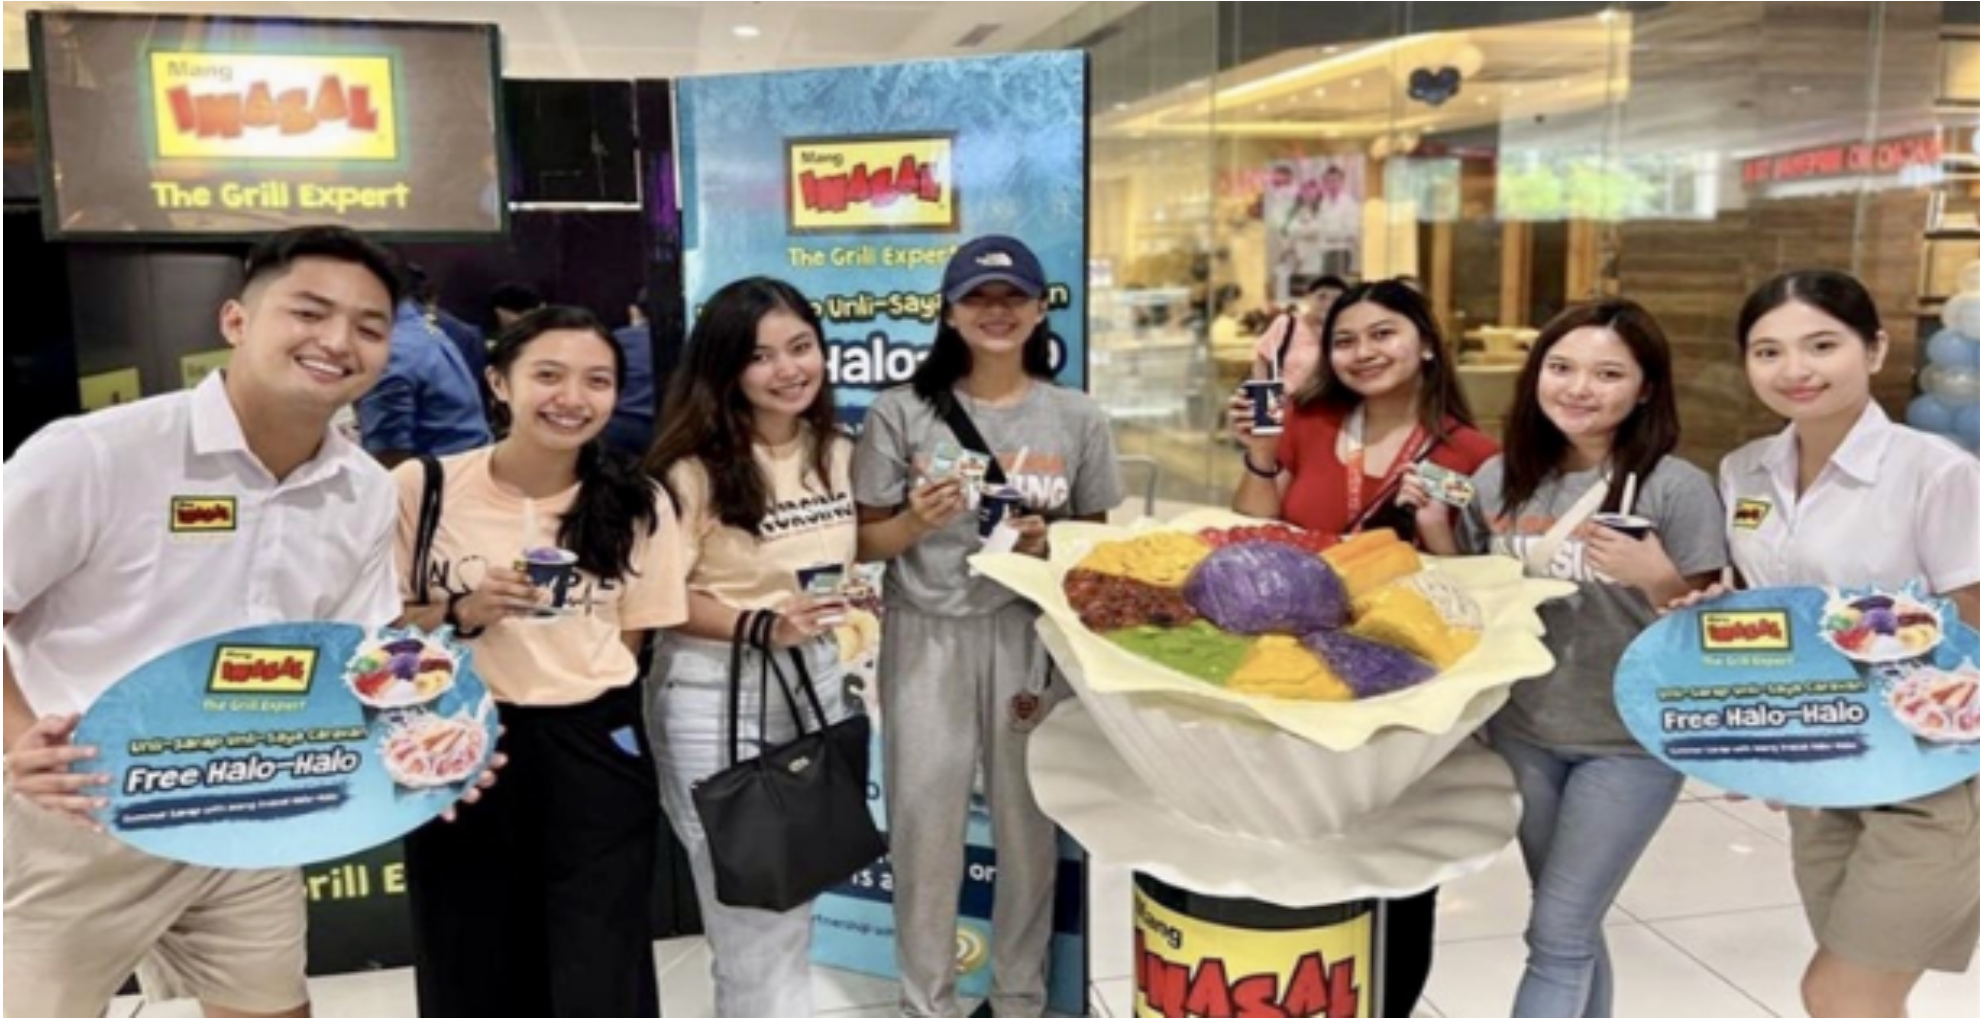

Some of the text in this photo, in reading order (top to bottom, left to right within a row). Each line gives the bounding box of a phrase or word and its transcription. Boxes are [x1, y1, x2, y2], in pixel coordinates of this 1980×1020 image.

[167, 61, 233, 80] Mang
[801, 151, 844, 167] Mang
[150, 179, 410, 214] The Grill Expert
[788, 246, 825, 267] The
[830, 244, 877, 267] Grill
[1664, 701, 1865, 730] Free Halo-Halo
[127, 747, 357, 793] Free Halo-Halo
[307, 863, 369, 901] rill
